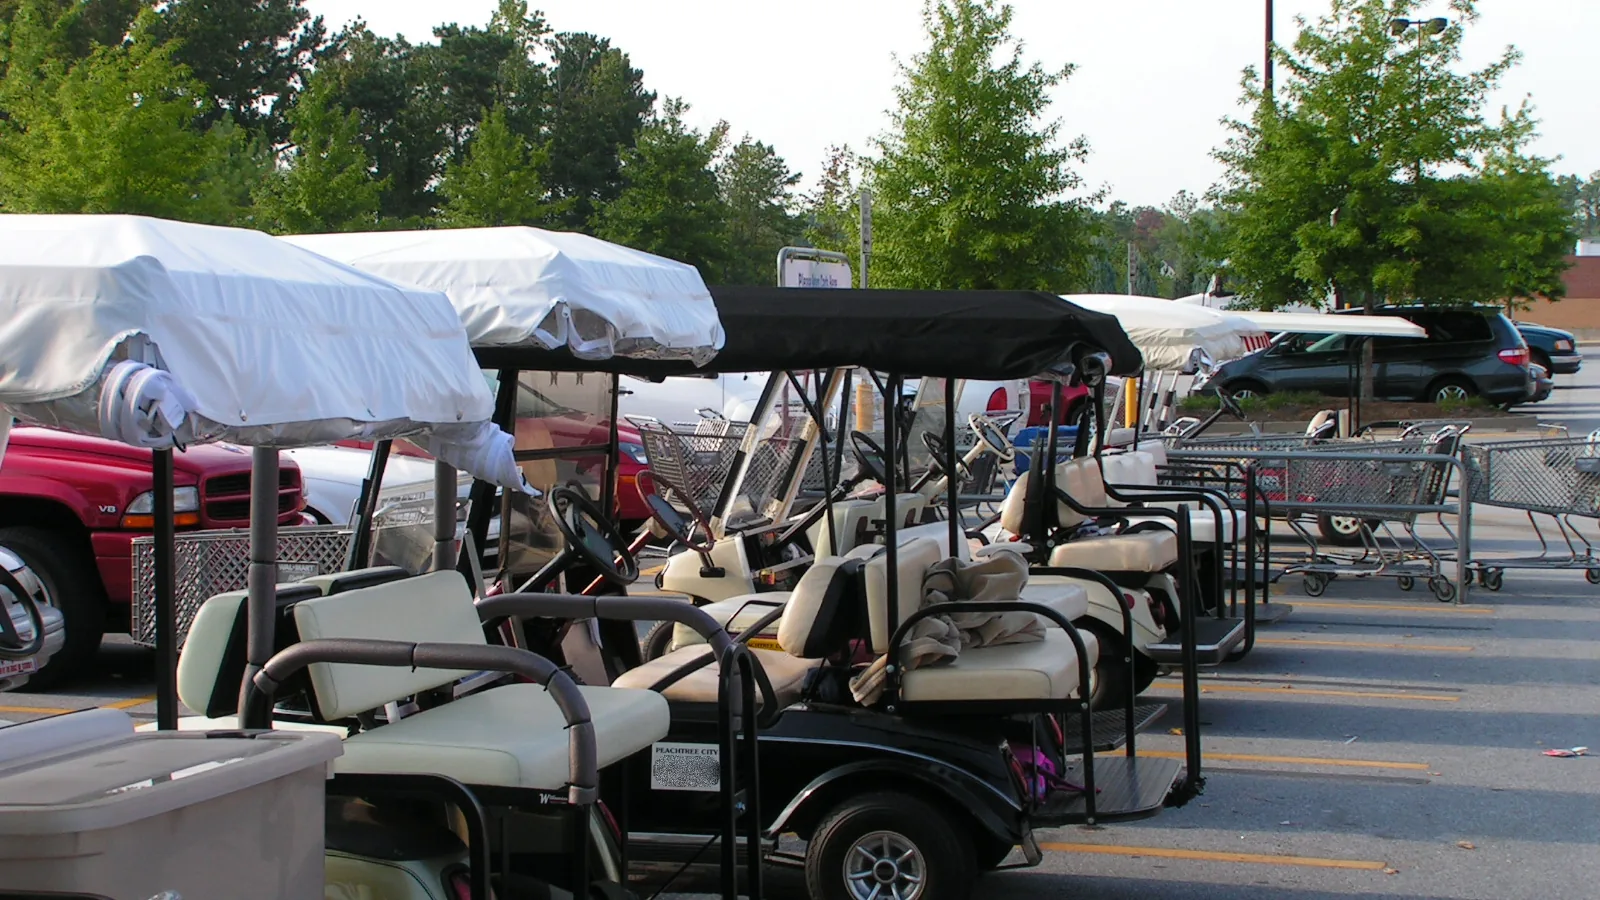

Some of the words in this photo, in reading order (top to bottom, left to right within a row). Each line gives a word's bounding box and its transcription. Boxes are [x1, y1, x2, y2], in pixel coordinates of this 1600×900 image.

[98, 505, 117, 513] V8
[655, 747, 699, 755] PEACHTREE
[700, 748, 719, 756] CITY
